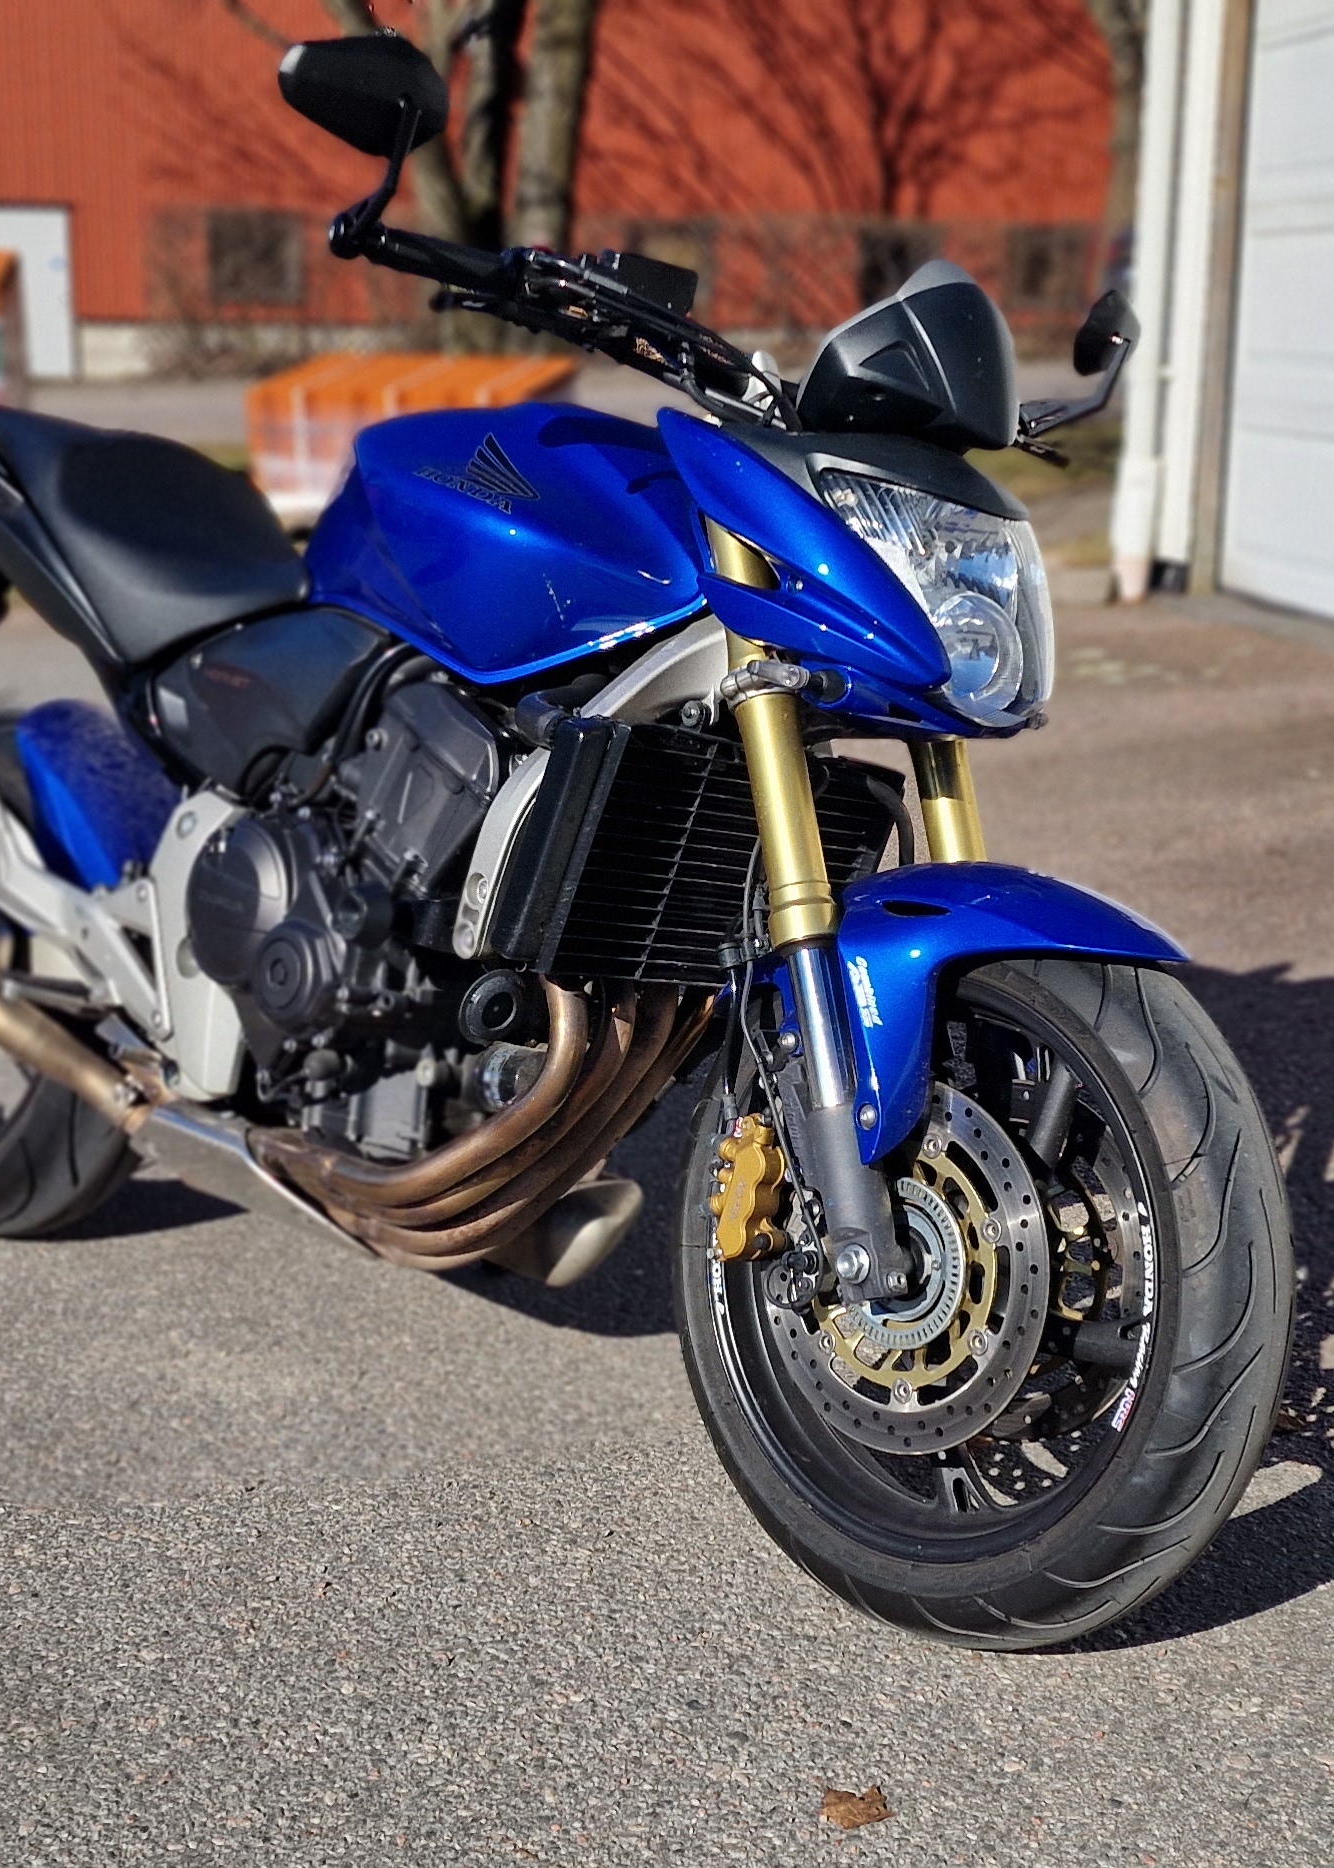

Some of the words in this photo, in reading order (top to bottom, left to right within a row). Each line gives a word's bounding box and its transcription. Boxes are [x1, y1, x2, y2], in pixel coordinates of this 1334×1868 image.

[412, 464, 512, 515] HONDA
[1141, 1224, 1154, 1317] HONDA
[1129, 1321, 1151, 1389] Racing
